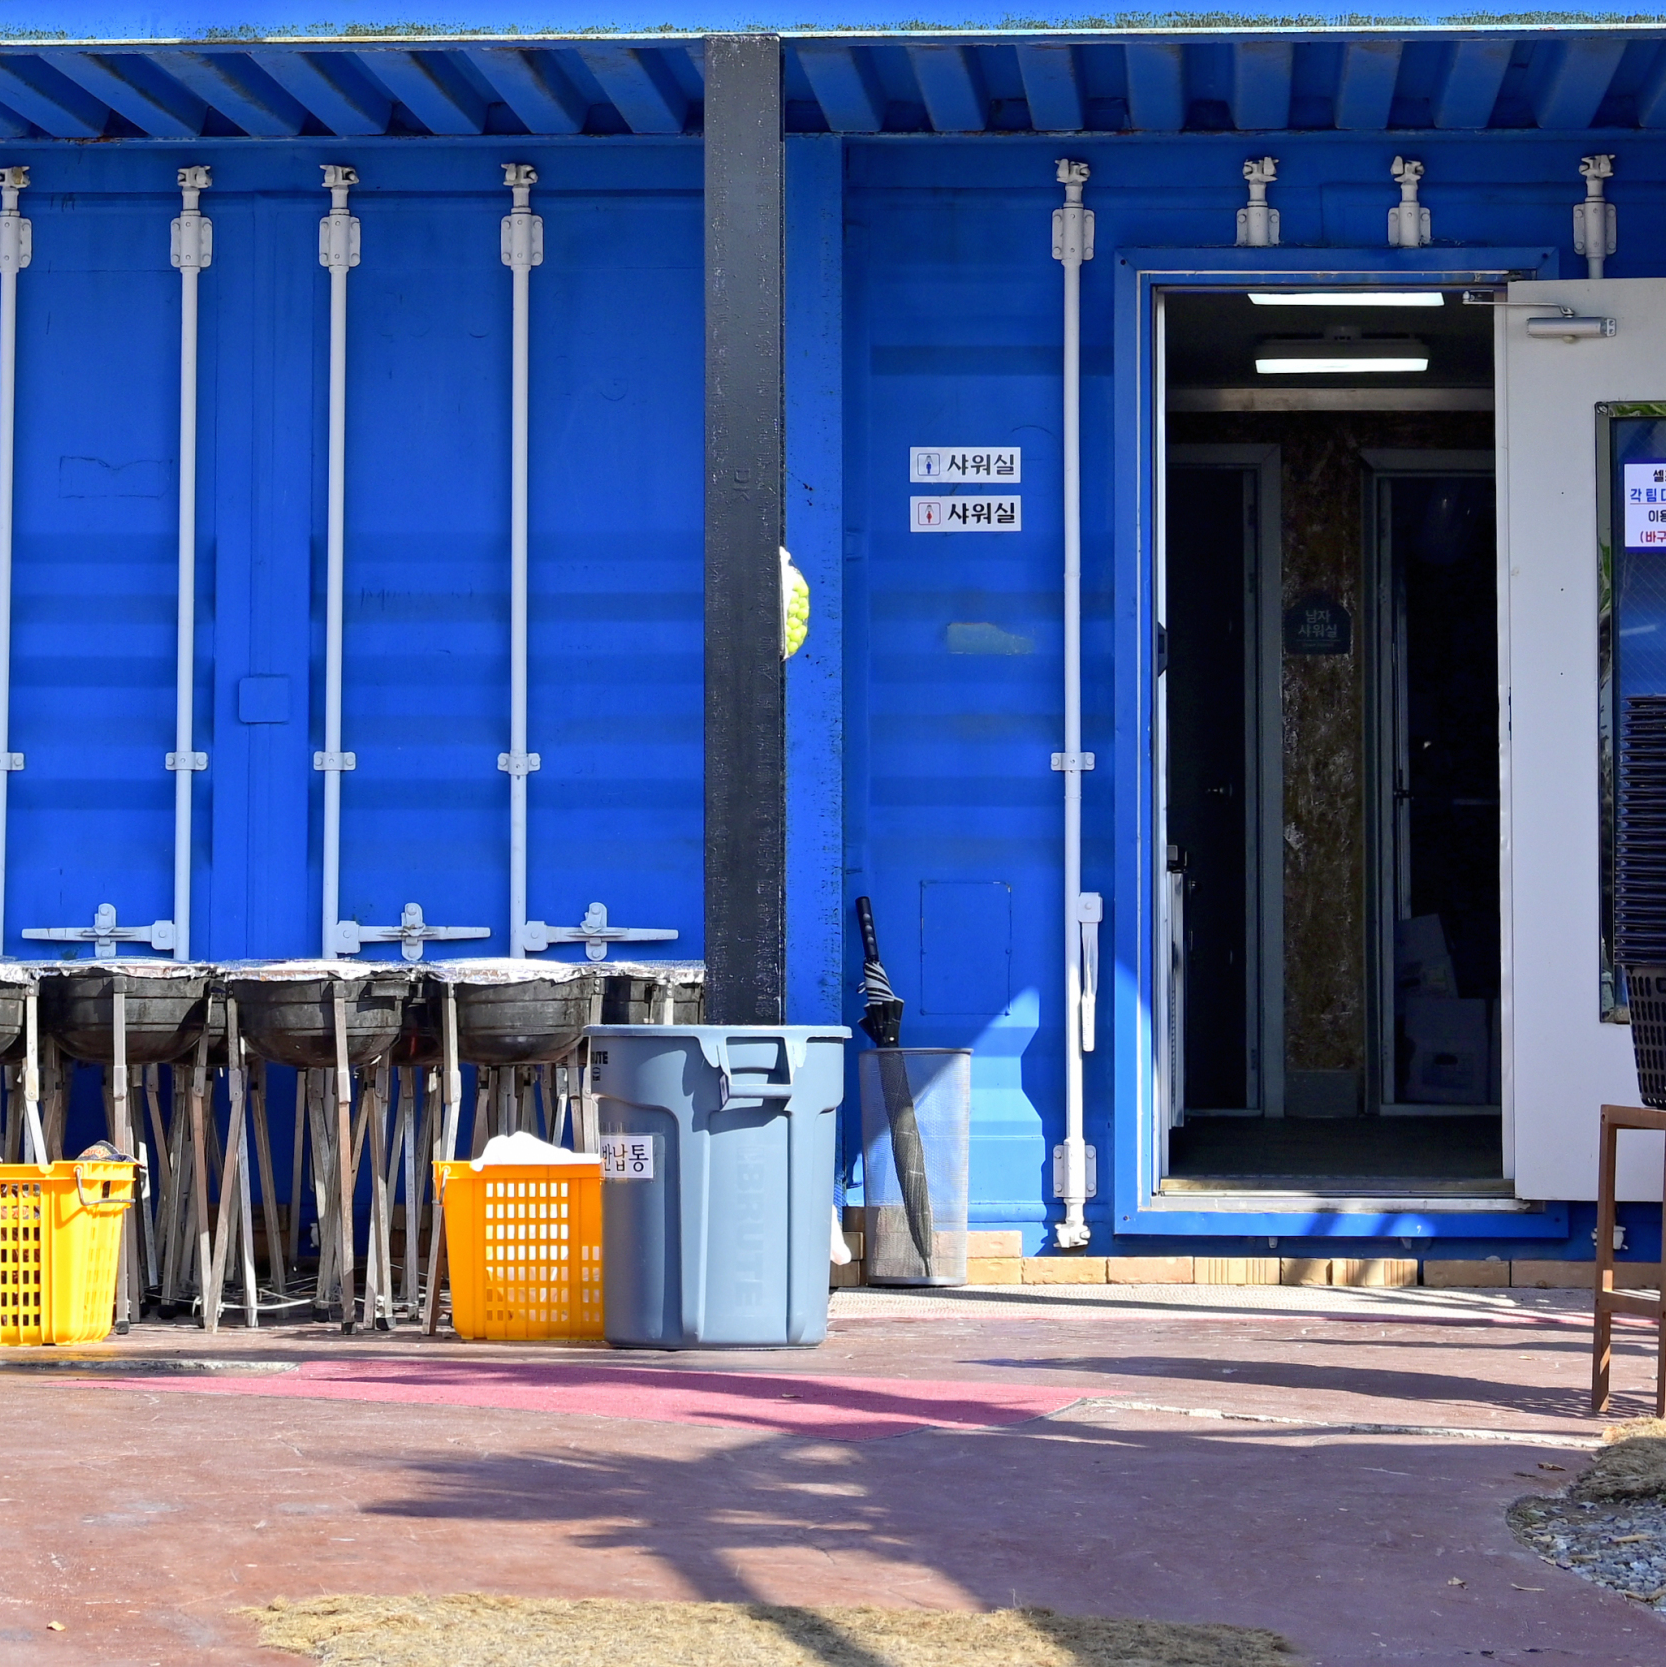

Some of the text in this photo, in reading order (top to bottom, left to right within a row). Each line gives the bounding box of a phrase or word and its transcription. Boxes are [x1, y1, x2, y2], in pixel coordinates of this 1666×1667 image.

[947, 454, 1015, 475] 샤워실
[1630, 488, 1642, 502] 각
[1645, 487, 1657, 502] 팀
[947, 502, 1015, 525] 샤워실
[1305, 609, 1331, 624] 남자
[602, 1143, 649, 1172] 반납통
